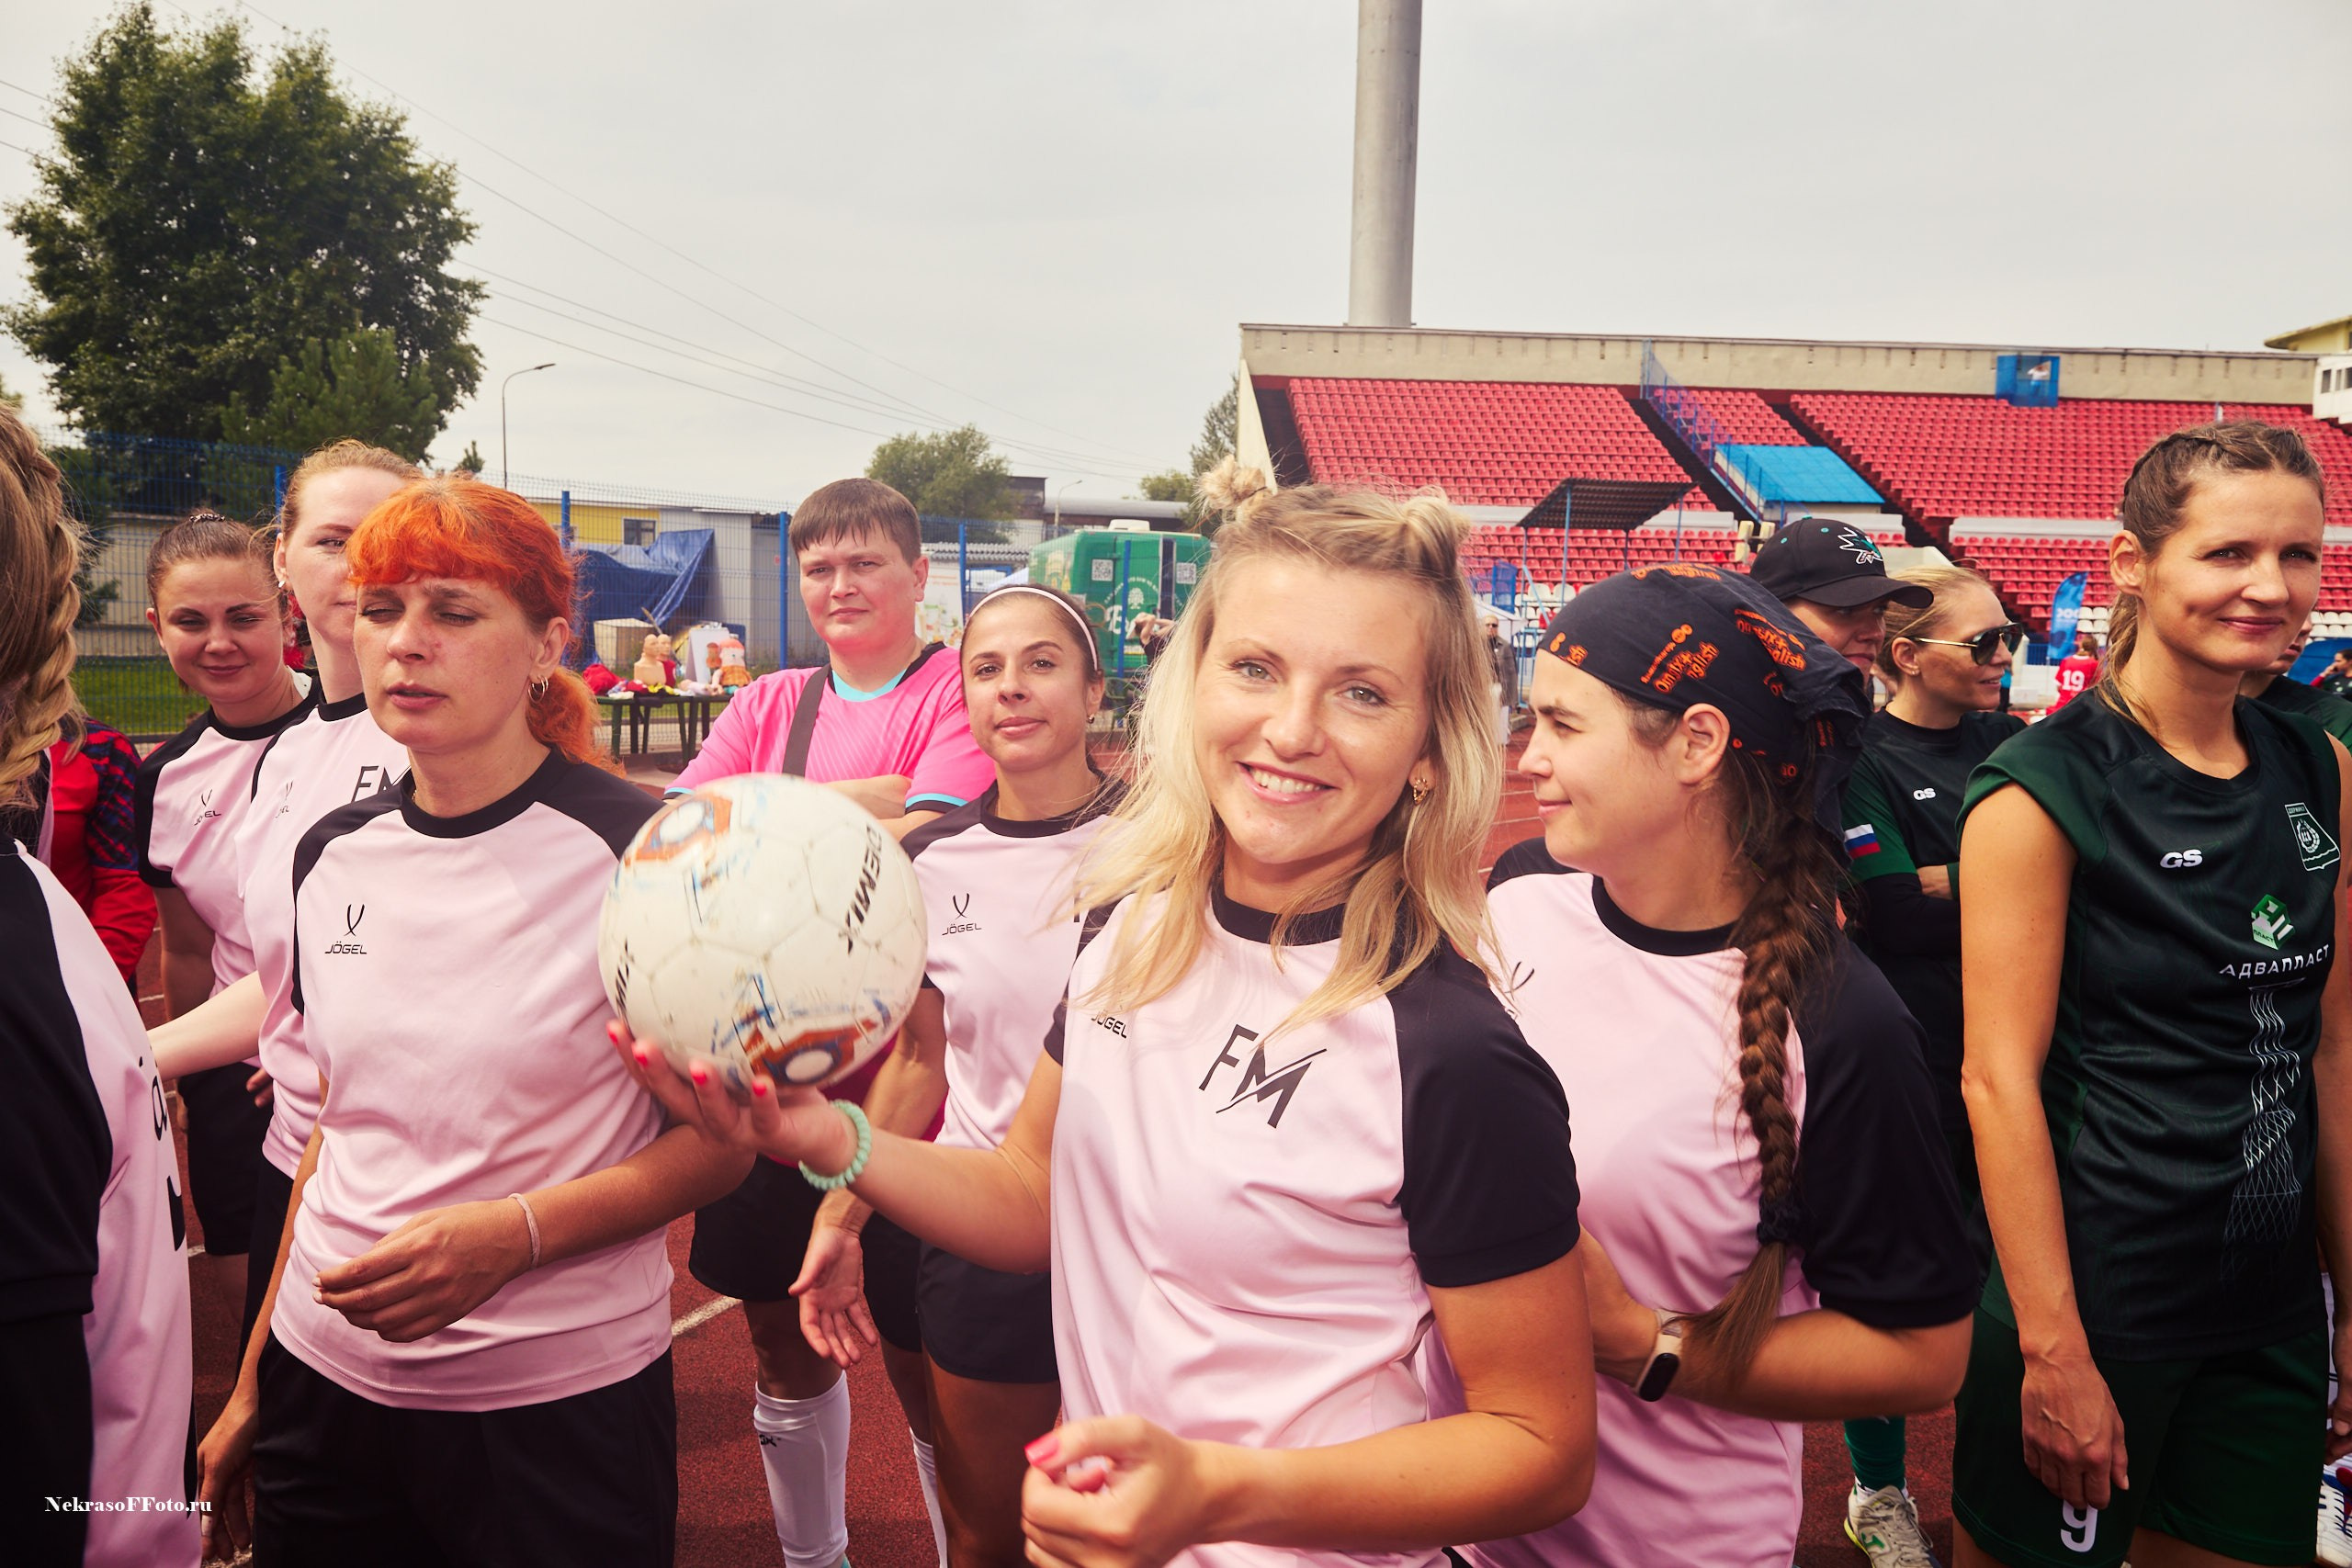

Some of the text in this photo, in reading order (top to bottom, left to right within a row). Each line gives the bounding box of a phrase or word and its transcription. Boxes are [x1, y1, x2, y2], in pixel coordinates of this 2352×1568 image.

[2062, 670, 2086, 691] 19
[1913, 787, 1937, 801] GS
[2160, 849, 2203, 869] GS
[941, 922, 982, 936] JÖGEL
[324, 940, 368, 954] JÖGEL
[2219, 943, 2330, 980] АДВАПЛАСТ
[1198, 1023, 1328, 1129] FM
[2060, 1499, 2098, 1552] 9
